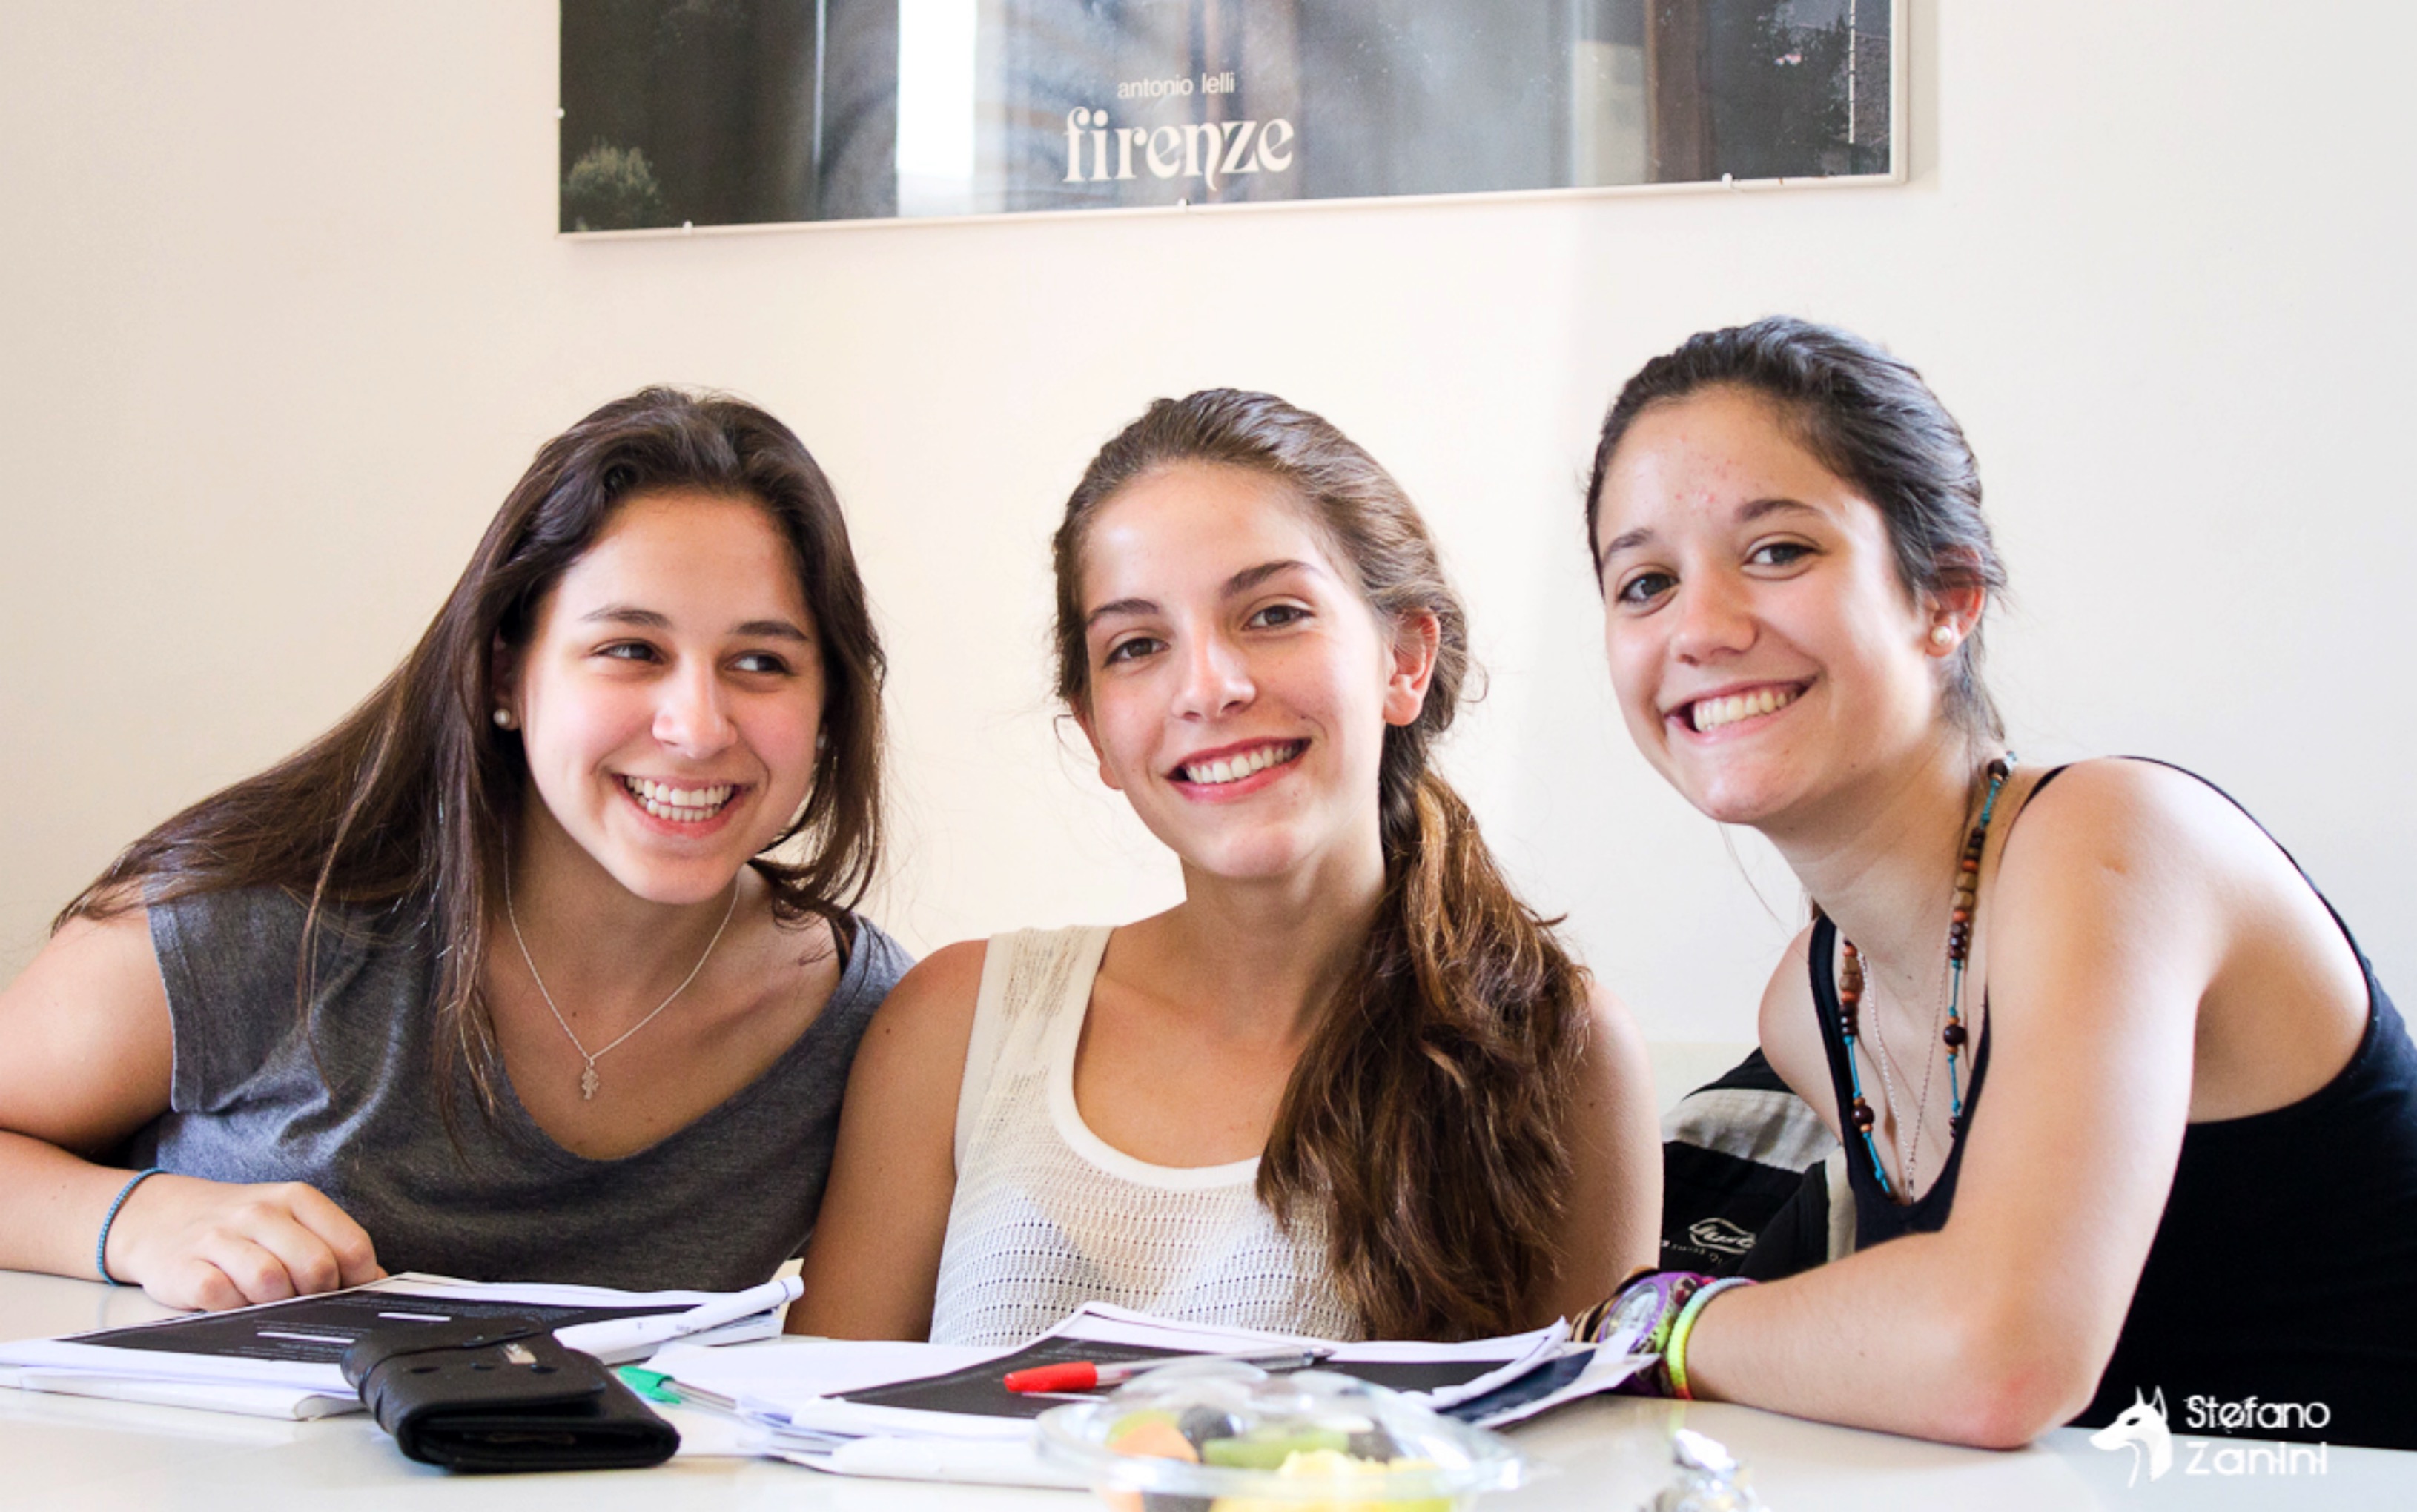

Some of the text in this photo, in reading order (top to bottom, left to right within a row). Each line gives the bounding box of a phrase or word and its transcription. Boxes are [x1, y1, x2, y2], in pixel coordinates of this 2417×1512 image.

[1117, 72, 1235, 99] antonio lelli
[1062, 106, 1295, 191] firenze
